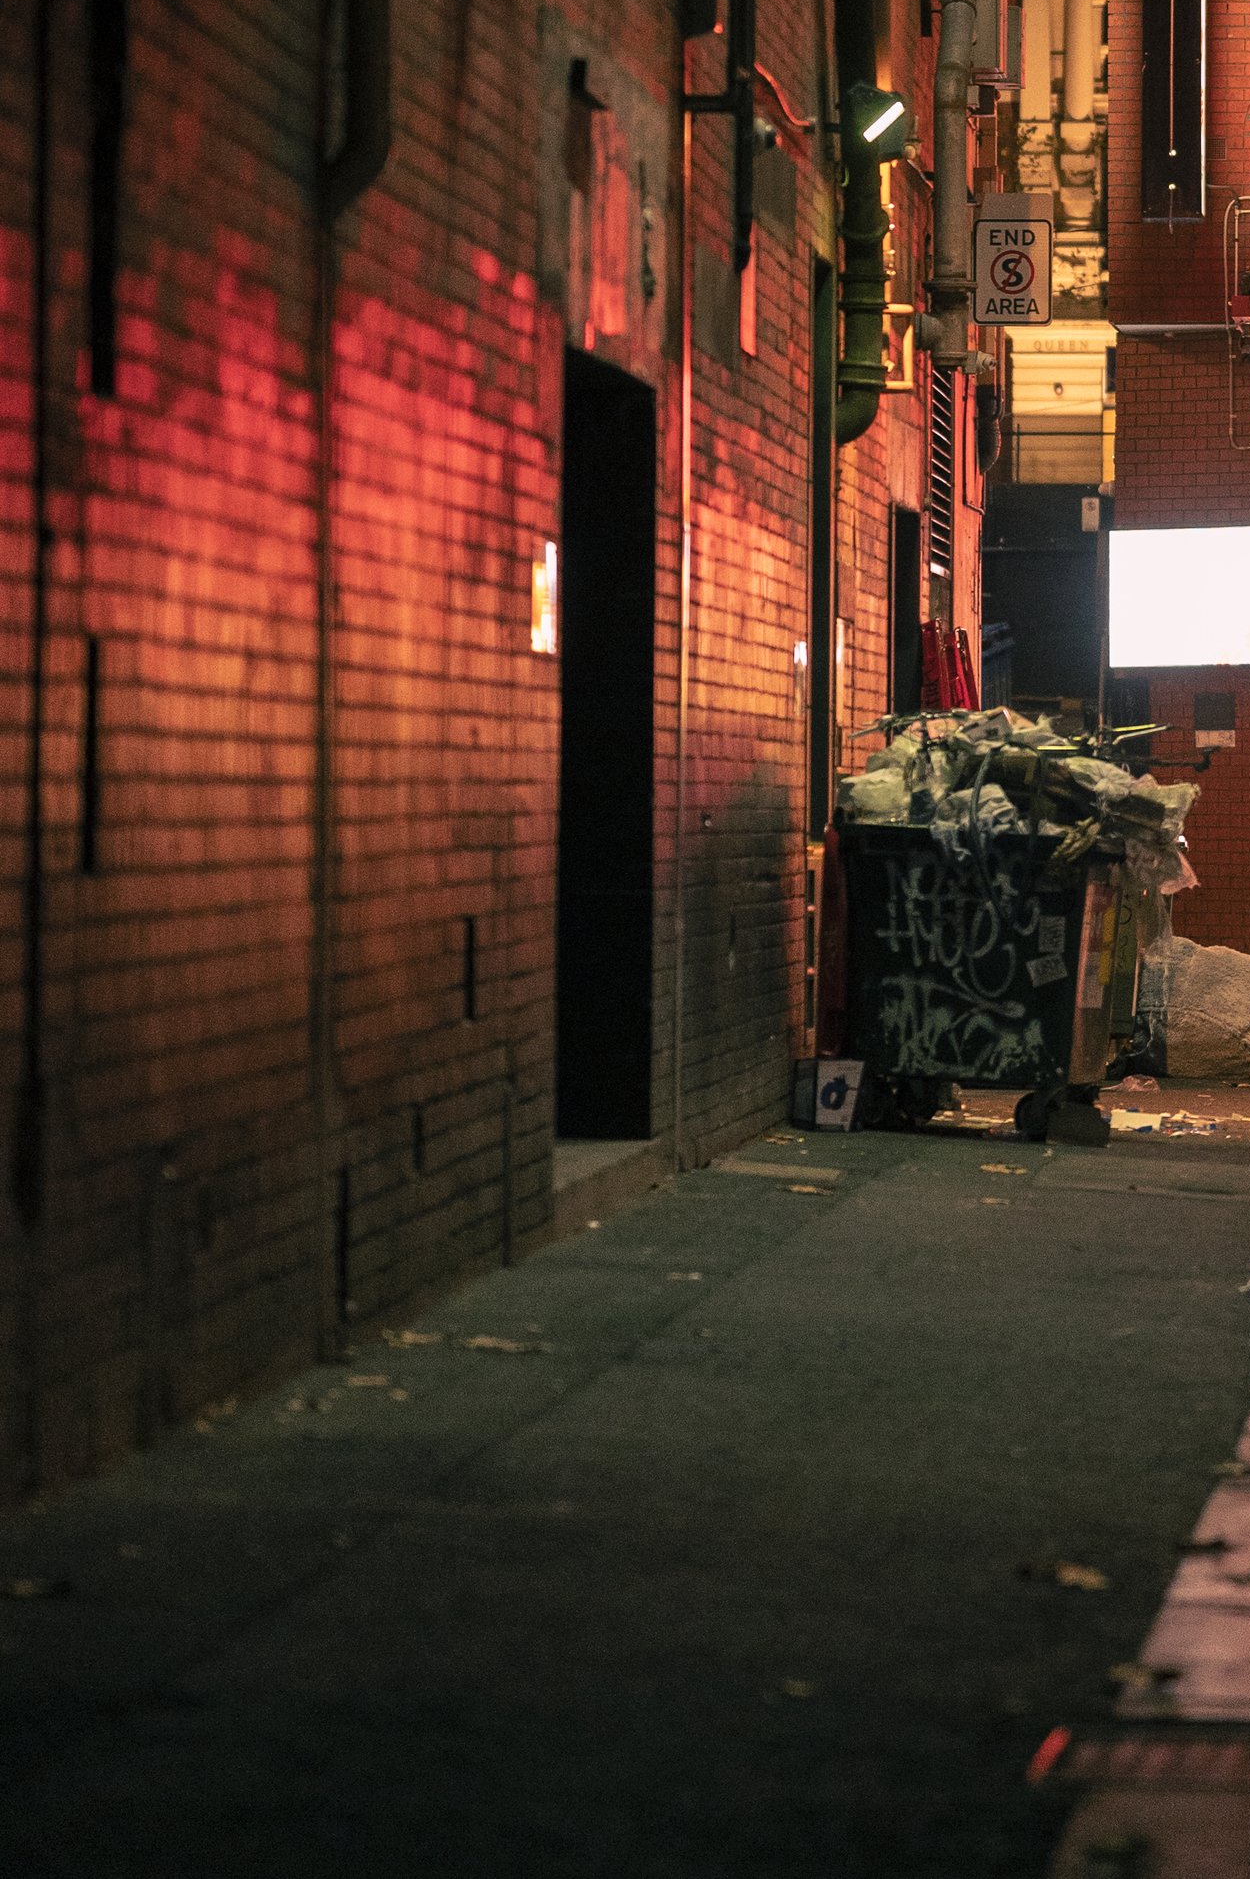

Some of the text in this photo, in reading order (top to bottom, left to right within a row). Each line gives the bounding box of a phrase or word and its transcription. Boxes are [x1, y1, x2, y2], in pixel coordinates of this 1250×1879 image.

[990, 230, 1035, 245] END
[986, 299, 1039, 314] AREA
[1033, 340, 1089, 352] QUEEN
